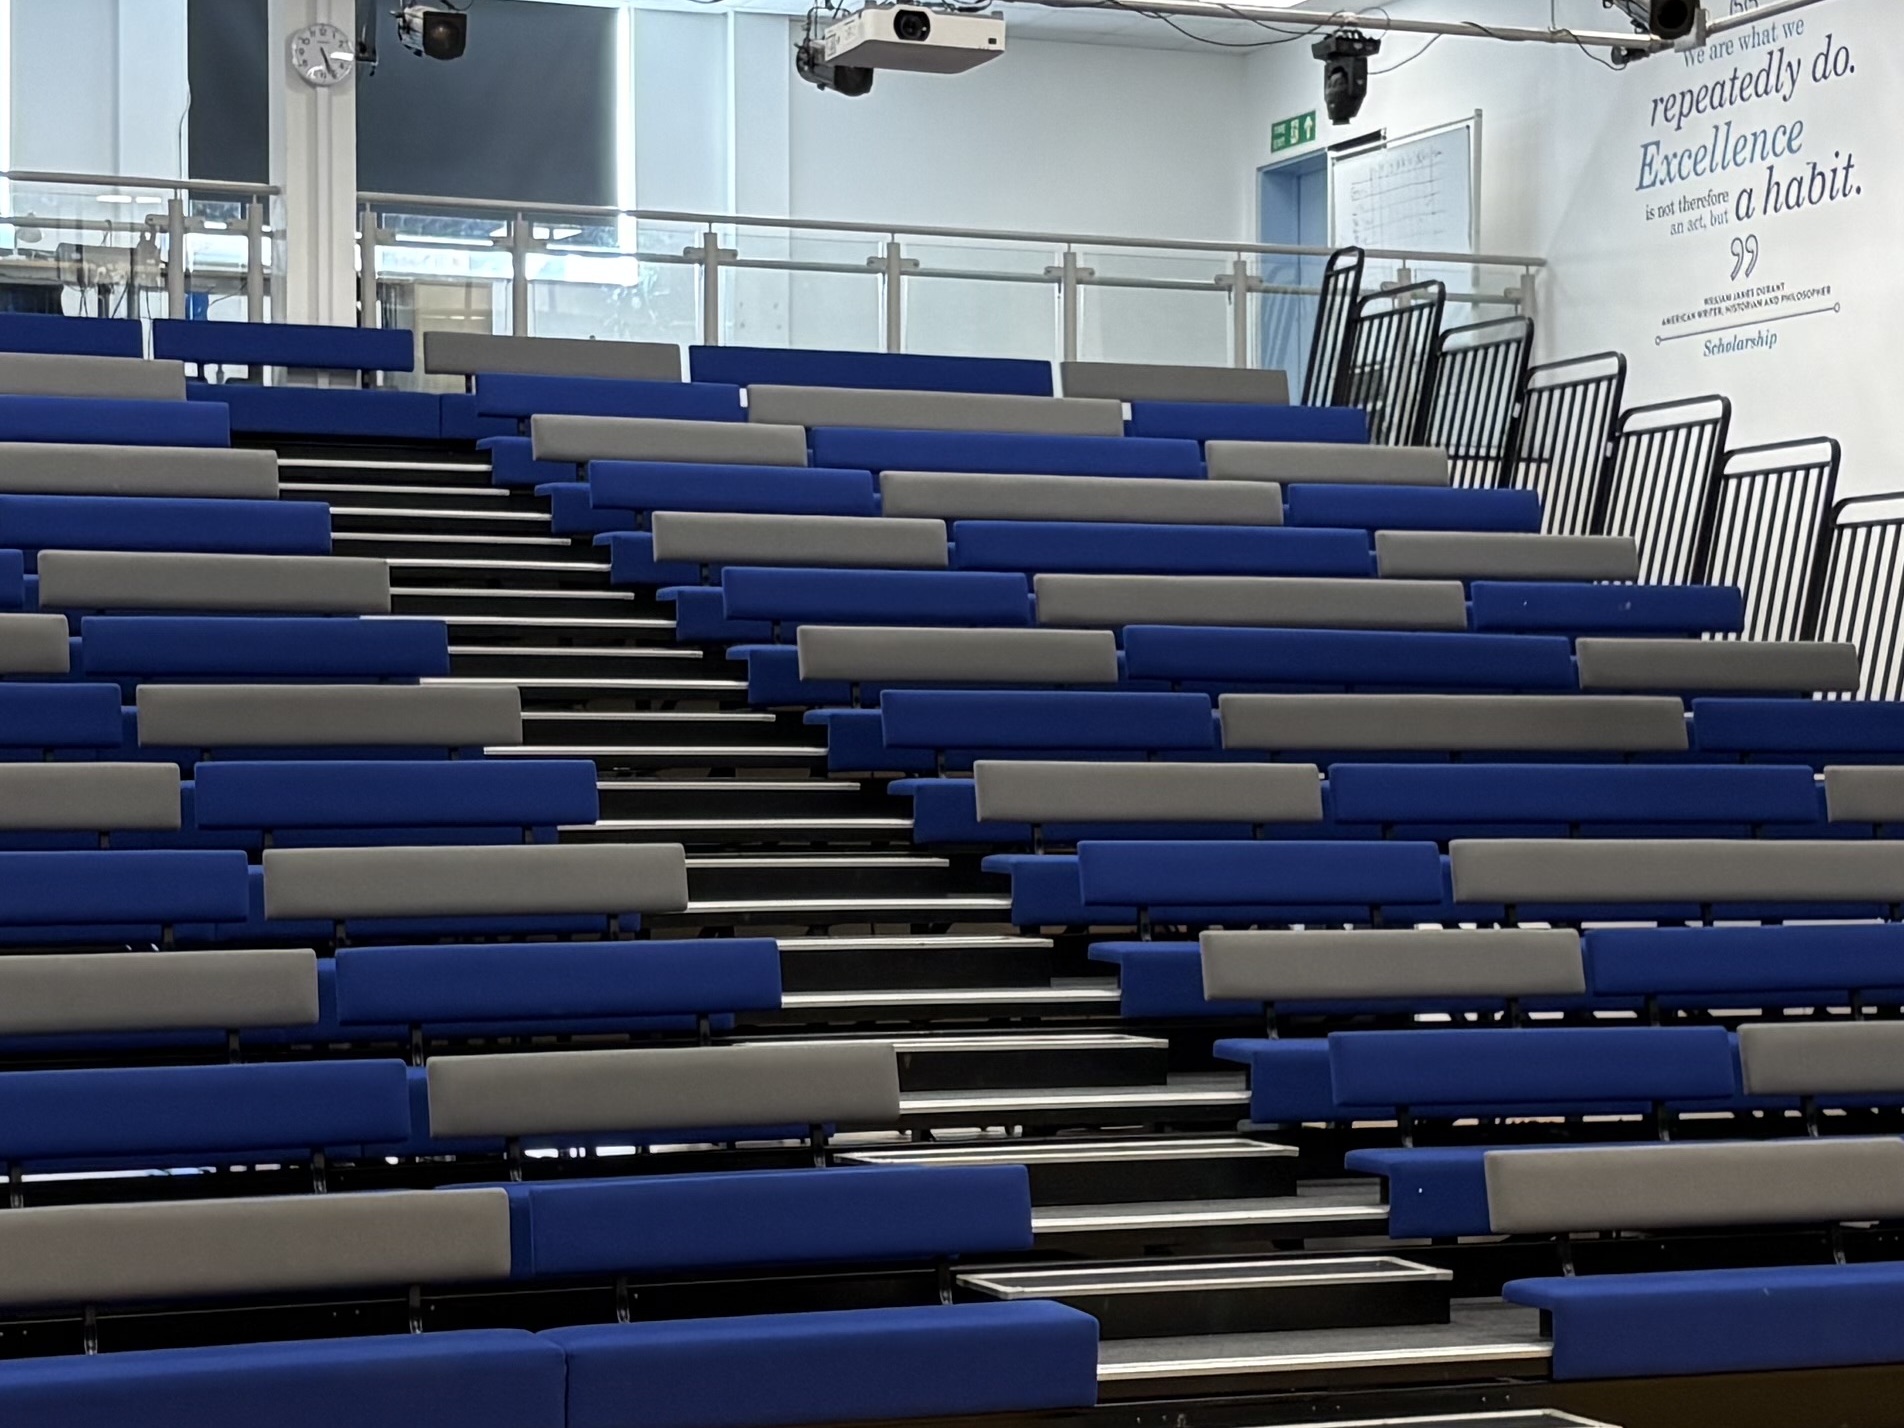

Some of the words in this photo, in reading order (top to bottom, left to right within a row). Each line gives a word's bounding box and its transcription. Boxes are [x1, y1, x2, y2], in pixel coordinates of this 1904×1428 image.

[1709, 39, 1734, 61] are
[1738, 21, 1777, 51] what
[1782, 19, 1804, 39] we
[1651, 47, 1801, 131] repeatedly
[1811, 33, 1855, 83] do.
[1635, 120, 1804, 191] Excellence
[1645, 204, 1655, 221] is
[1657, 201, 1675, 219] not
[1678, 188, 1729, 212] therefore
[1735, 187, 1755, 221] a
[1762, 150, 1862, 216] habit.
[1670, 220, 1684, 236] an
[1687, 216, 1707, 232] act,
[1709, 209, 1729, 227] but
[1703, 329, 1777, 357] Scholarship
